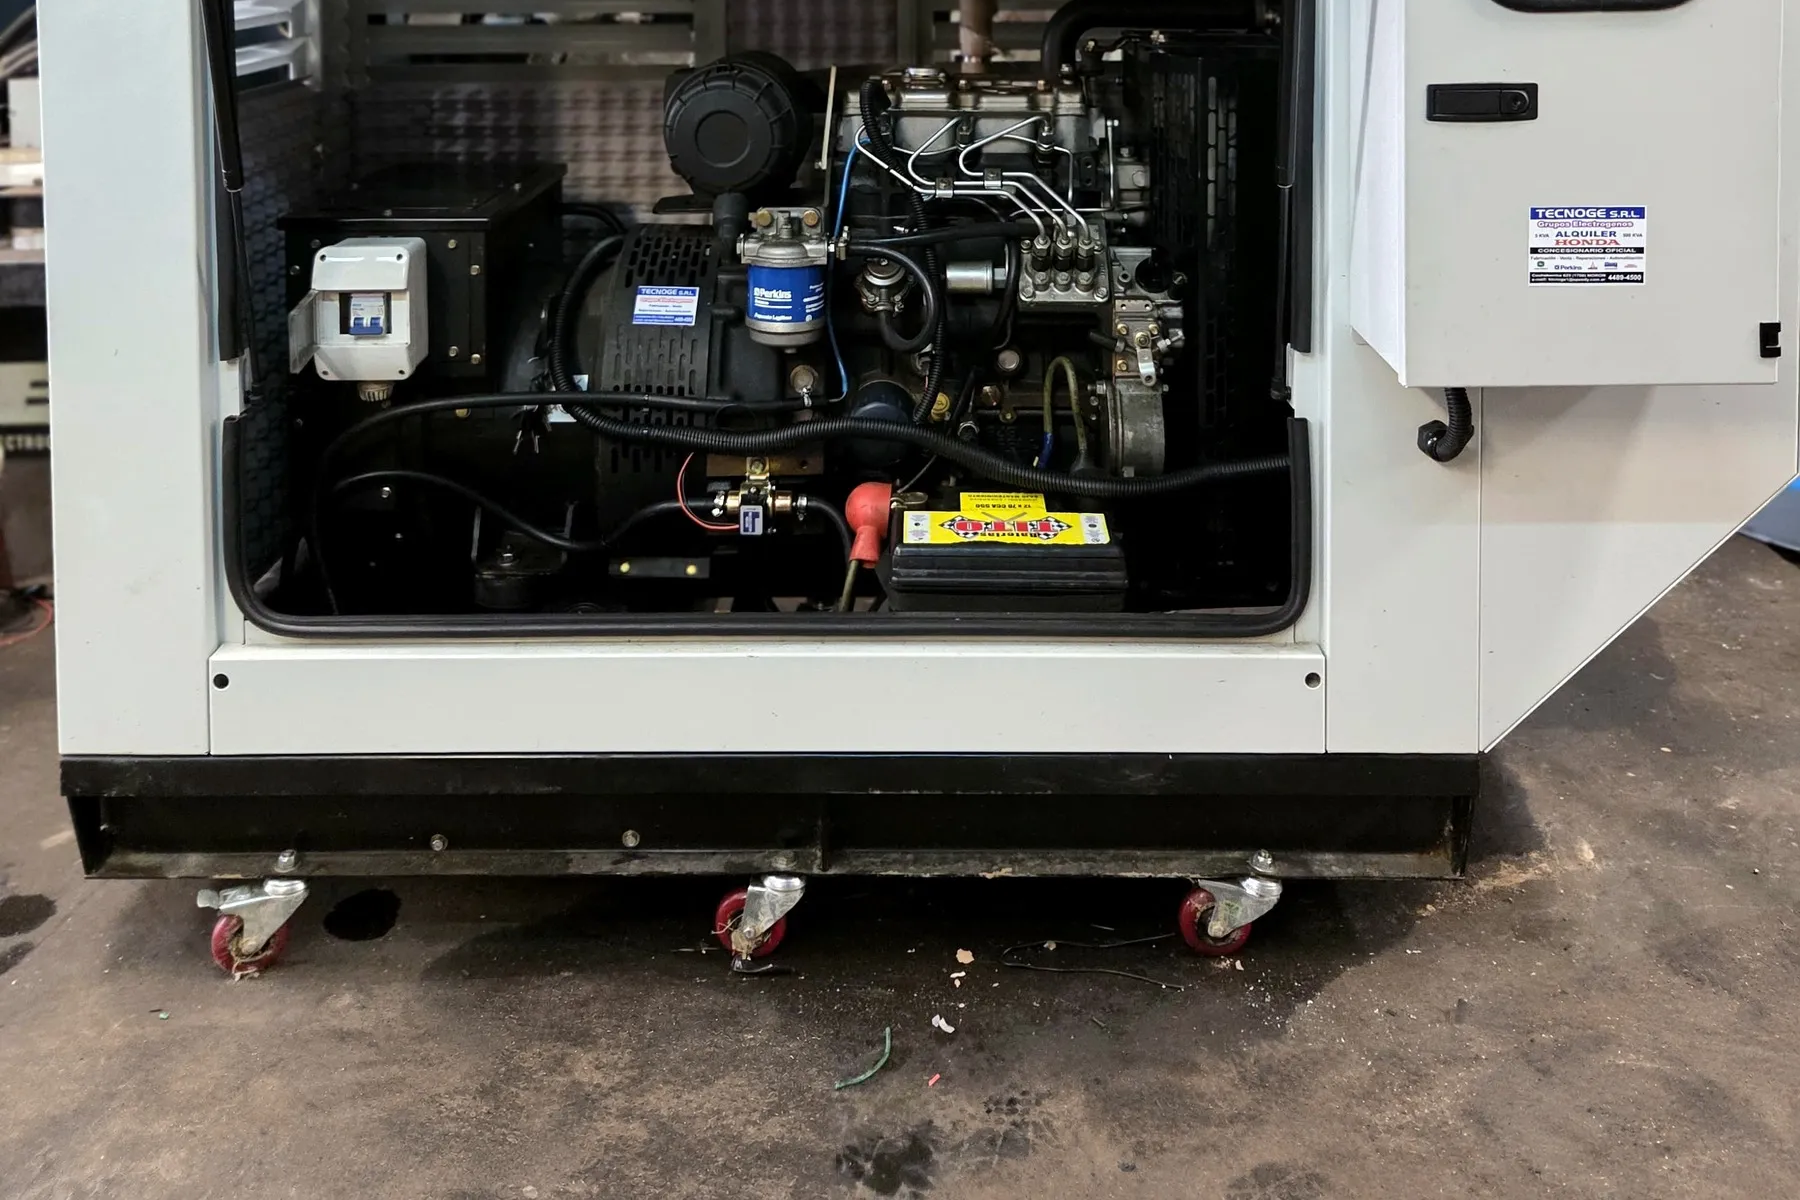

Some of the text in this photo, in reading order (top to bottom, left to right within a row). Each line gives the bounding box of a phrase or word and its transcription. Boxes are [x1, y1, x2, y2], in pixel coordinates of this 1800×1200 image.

[1535, 209, 1606, 218] TECNOGE
[1537, 220, 1571, 229] Grupos
[1555, 230, 1617, 238] ALQUILER
[1554, 238, 1621, 246] HONDA
[759, 287, 792, 298] Perkins
